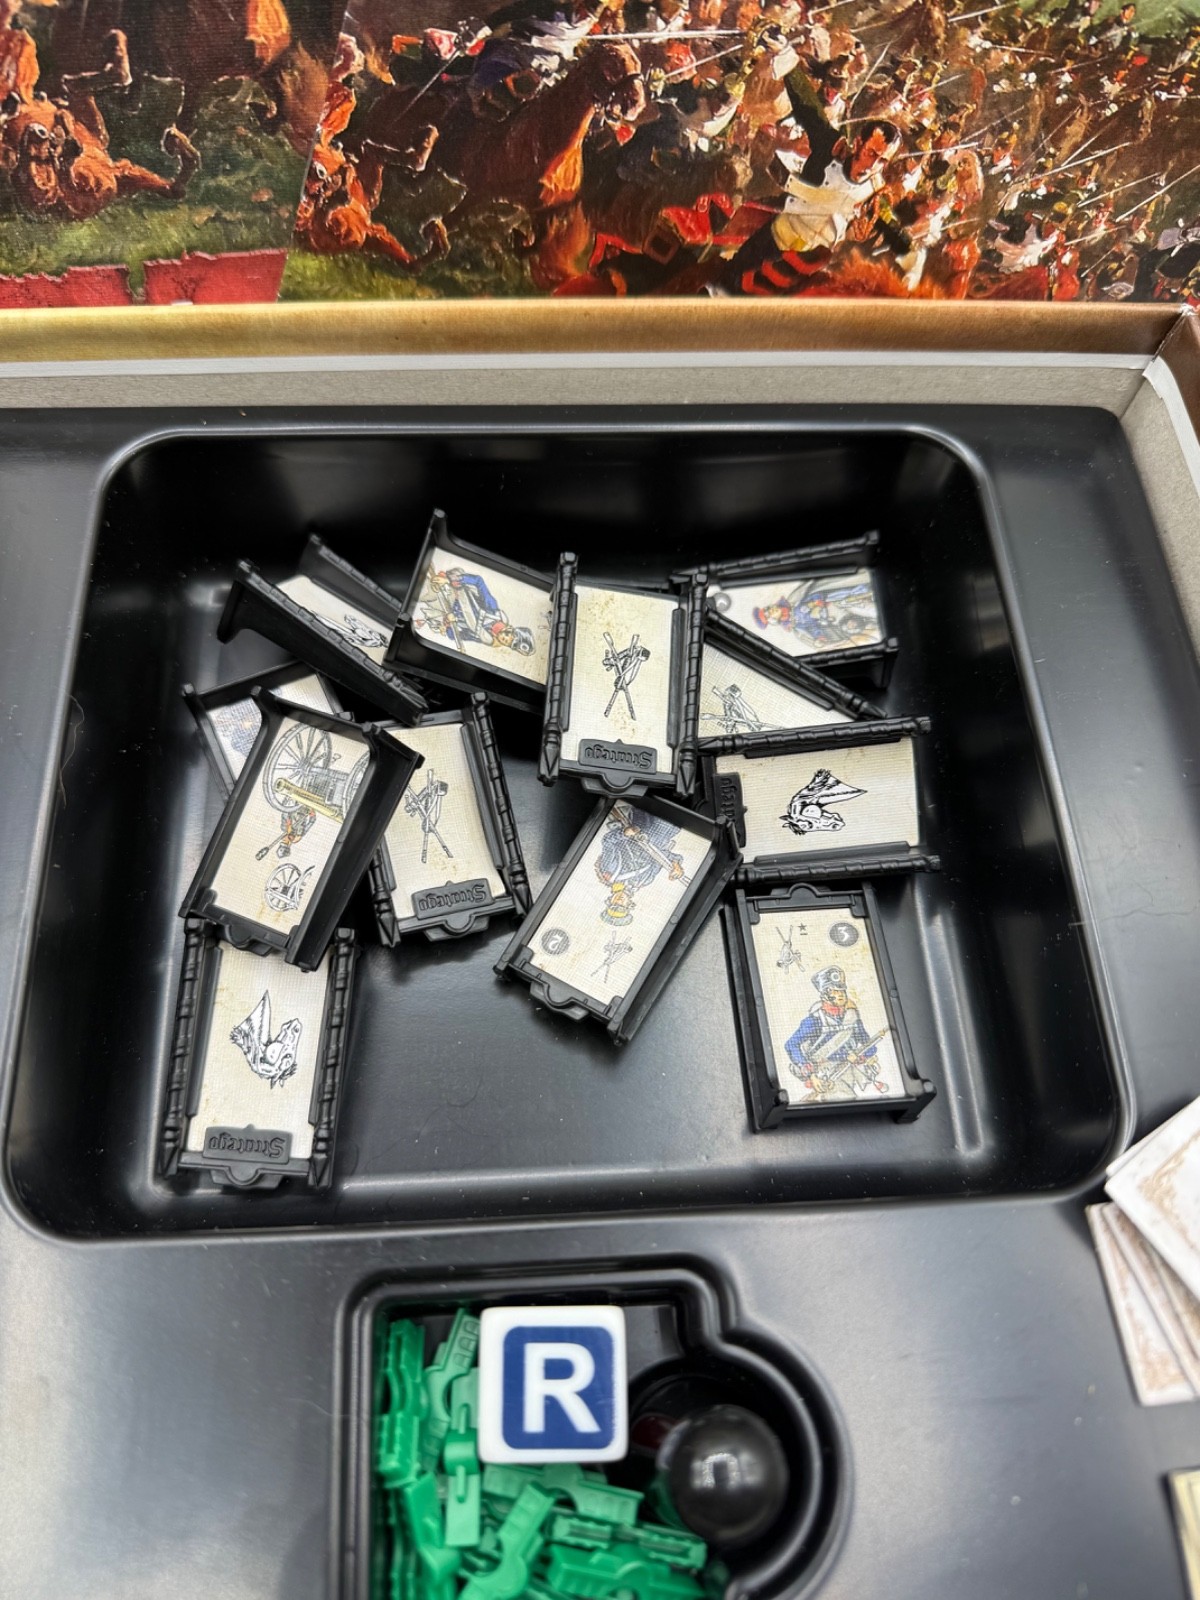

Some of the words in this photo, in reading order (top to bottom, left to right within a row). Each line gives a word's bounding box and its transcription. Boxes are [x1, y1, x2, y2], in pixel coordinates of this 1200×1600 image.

[584, 743, 653, 769] Stratego
[418, 884, 485, 911] Stratego
[208, 1131, 285, 1158] Stratego
[523, 1342, 601, 1433] R
